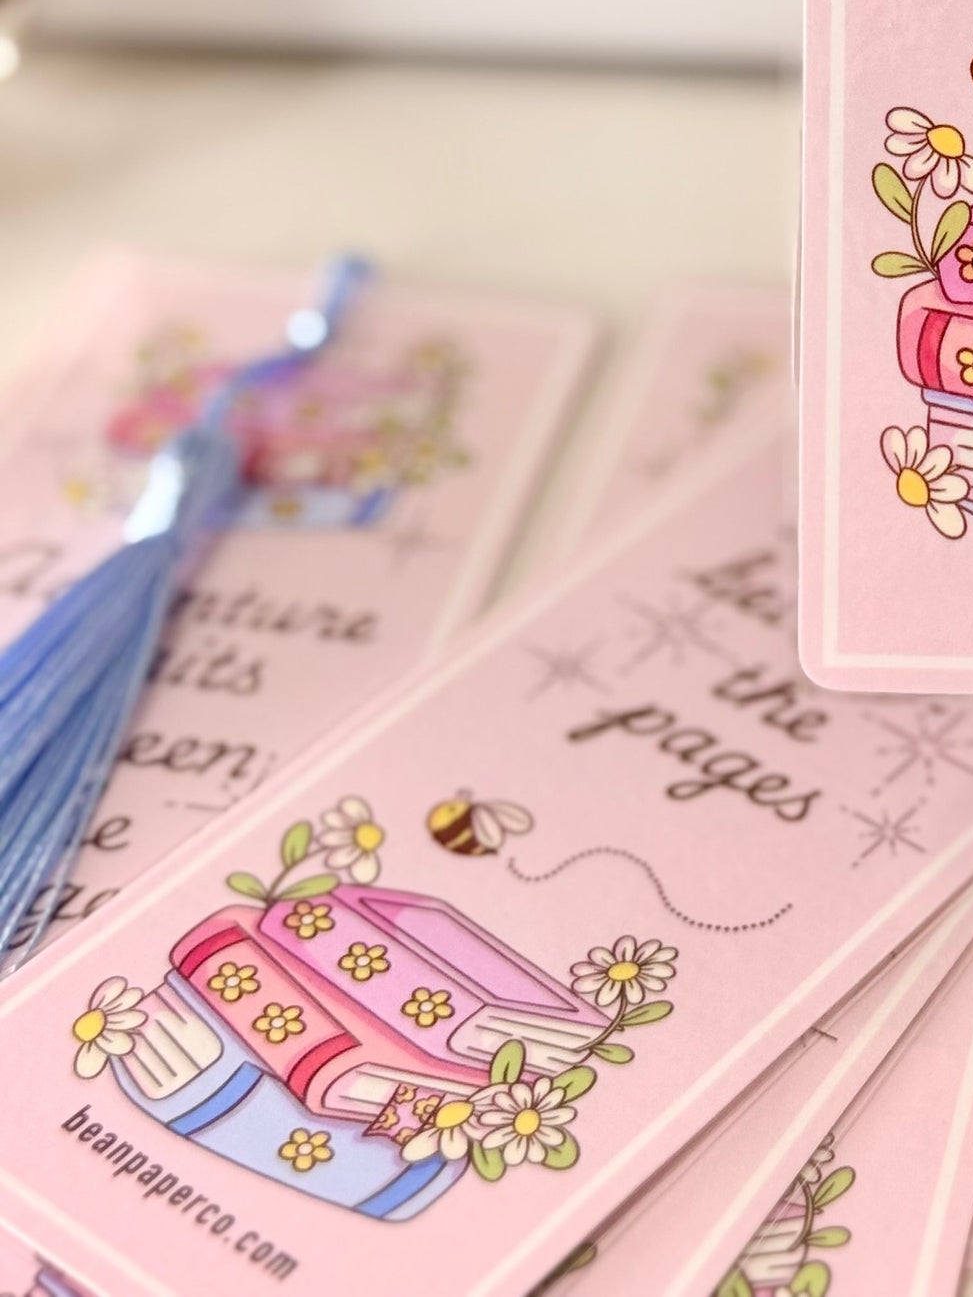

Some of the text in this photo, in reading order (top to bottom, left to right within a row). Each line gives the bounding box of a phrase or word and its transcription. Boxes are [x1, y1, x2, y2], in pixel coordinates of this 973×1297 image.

[565, 701, 826, 824] pages
[709, 664, 830, 744] the
[60, 1103, 301, 1283] beanpaperco.com
